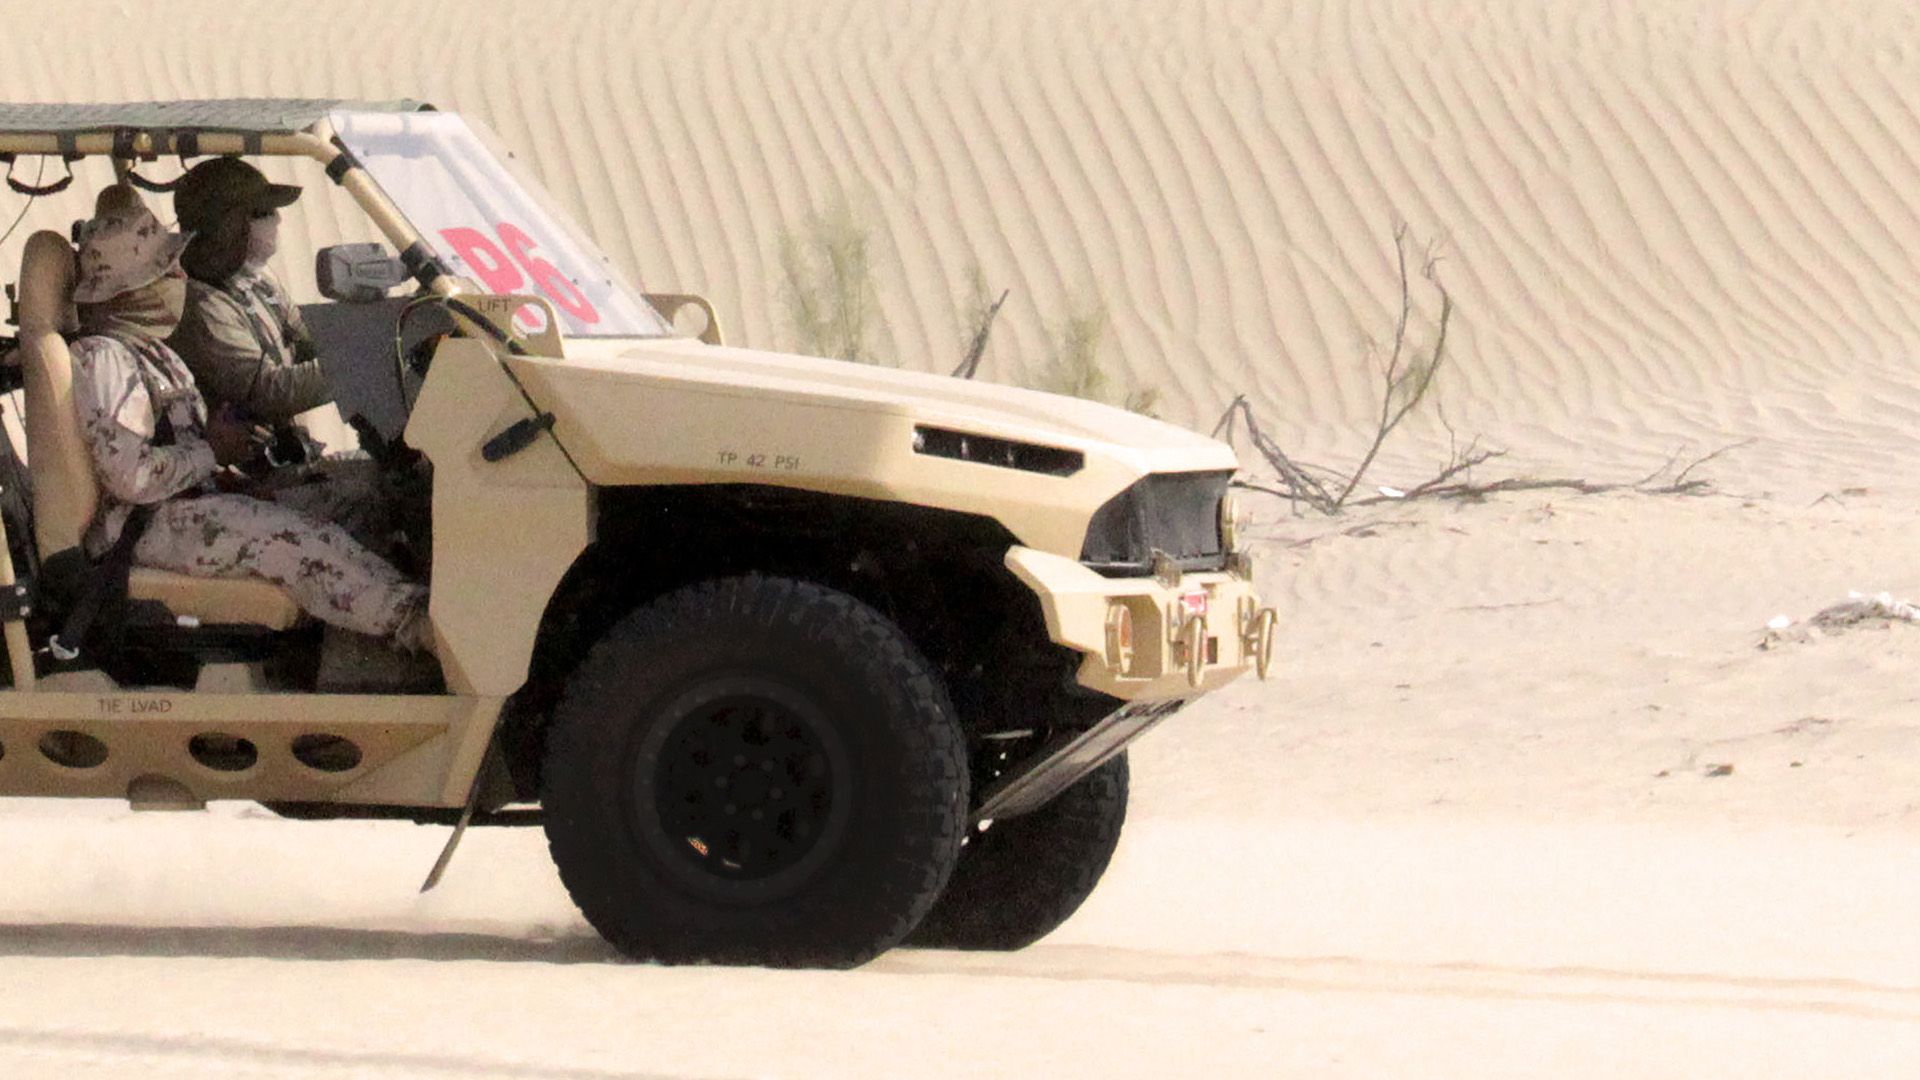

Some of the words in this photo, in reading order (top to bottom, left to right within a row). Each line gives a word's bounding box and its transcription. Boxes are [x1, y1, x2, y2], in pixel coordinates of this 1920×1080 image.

[438, 223, 600, 328] P6
[477, 298, 511, 312] LIFT
[718, 450, 738, 465] TP
[746, 454, 765, 467] 42
[775, 455, 800, 470] PSI
[97, 698, 121, 713] TIE
